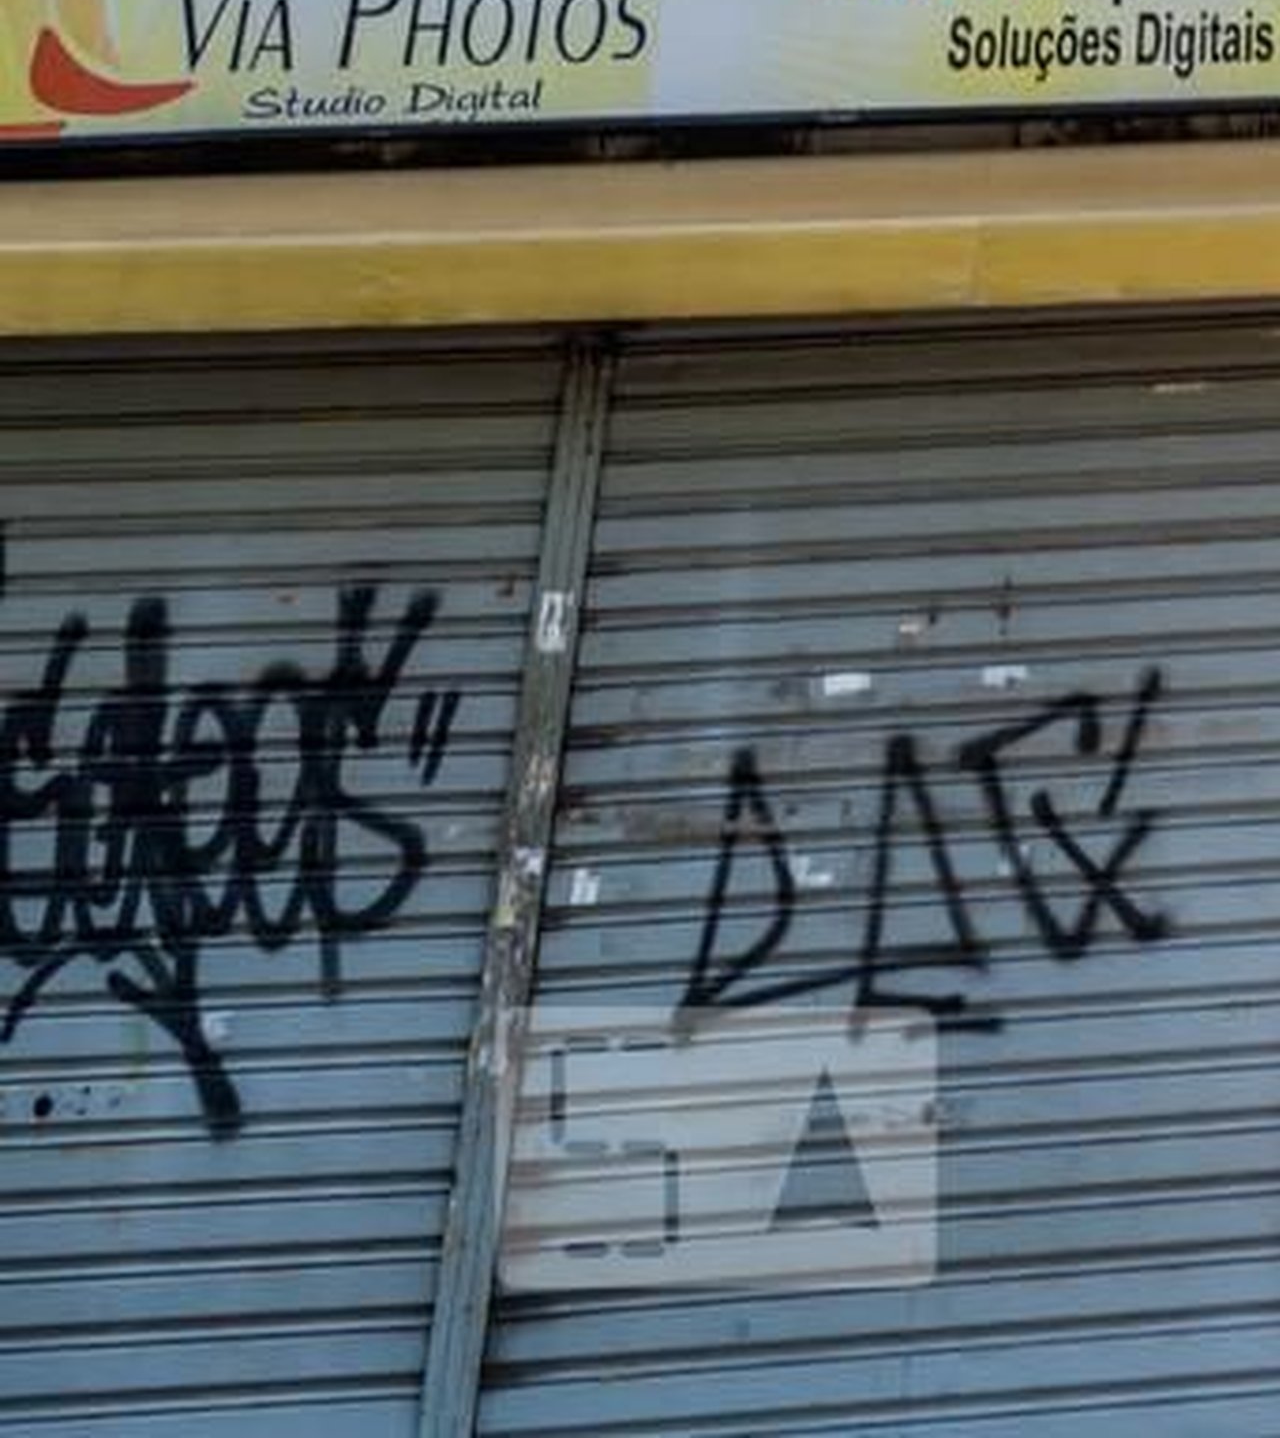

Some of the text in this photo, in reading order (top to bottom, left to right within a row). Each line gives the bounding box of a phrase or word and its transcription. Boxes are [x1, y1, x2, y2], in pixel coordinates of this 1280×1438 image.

[946, 9, 1276, 81] Soluções Digitais
[242, 79, 543, 122] Studio Digital
